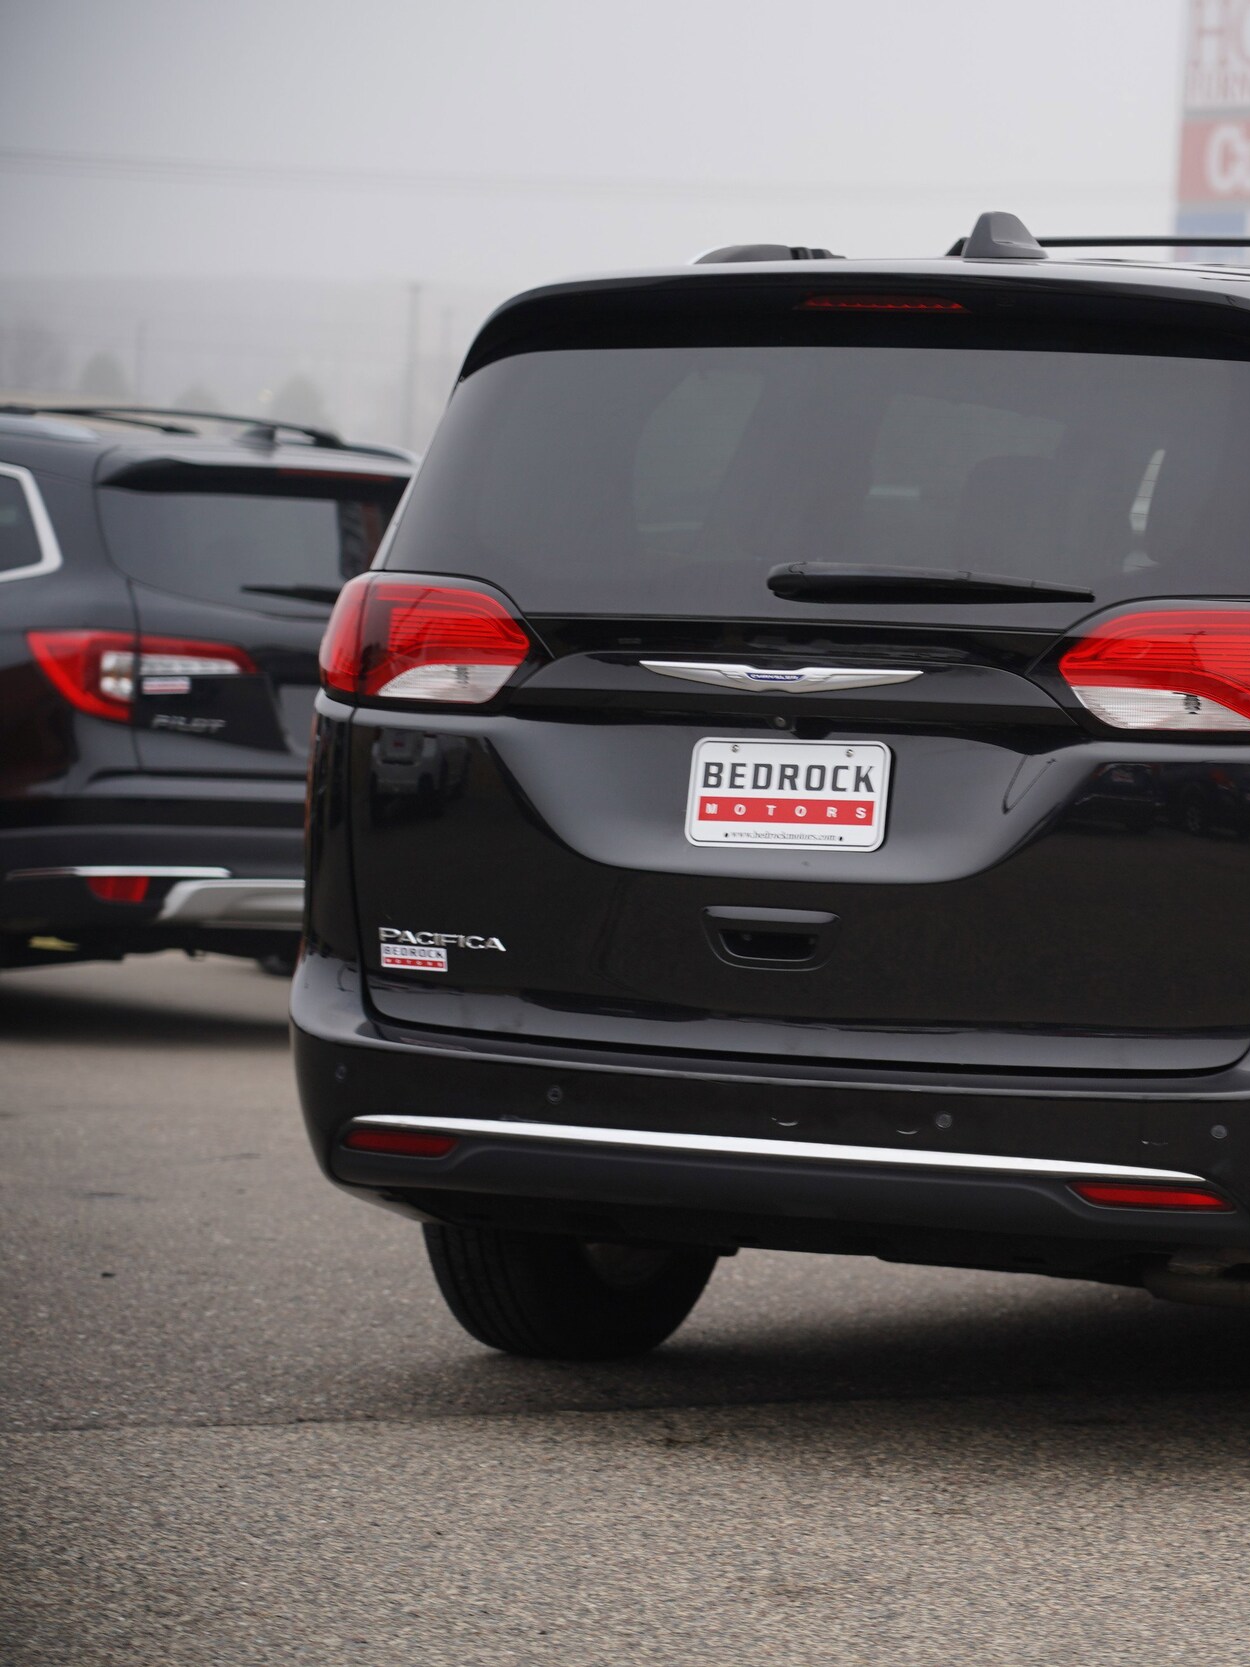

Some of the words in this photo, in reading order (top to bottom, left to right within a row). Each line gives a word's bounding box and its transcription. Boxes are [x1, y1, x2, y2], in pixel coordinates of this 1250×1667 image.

[702, 761, 875, 793] BEDROCK
[705, 802, 867, 819] MOTORS
[378, 926, 507, 952] PACIFICA
[384, 946, 444, 959] BEDROCK
